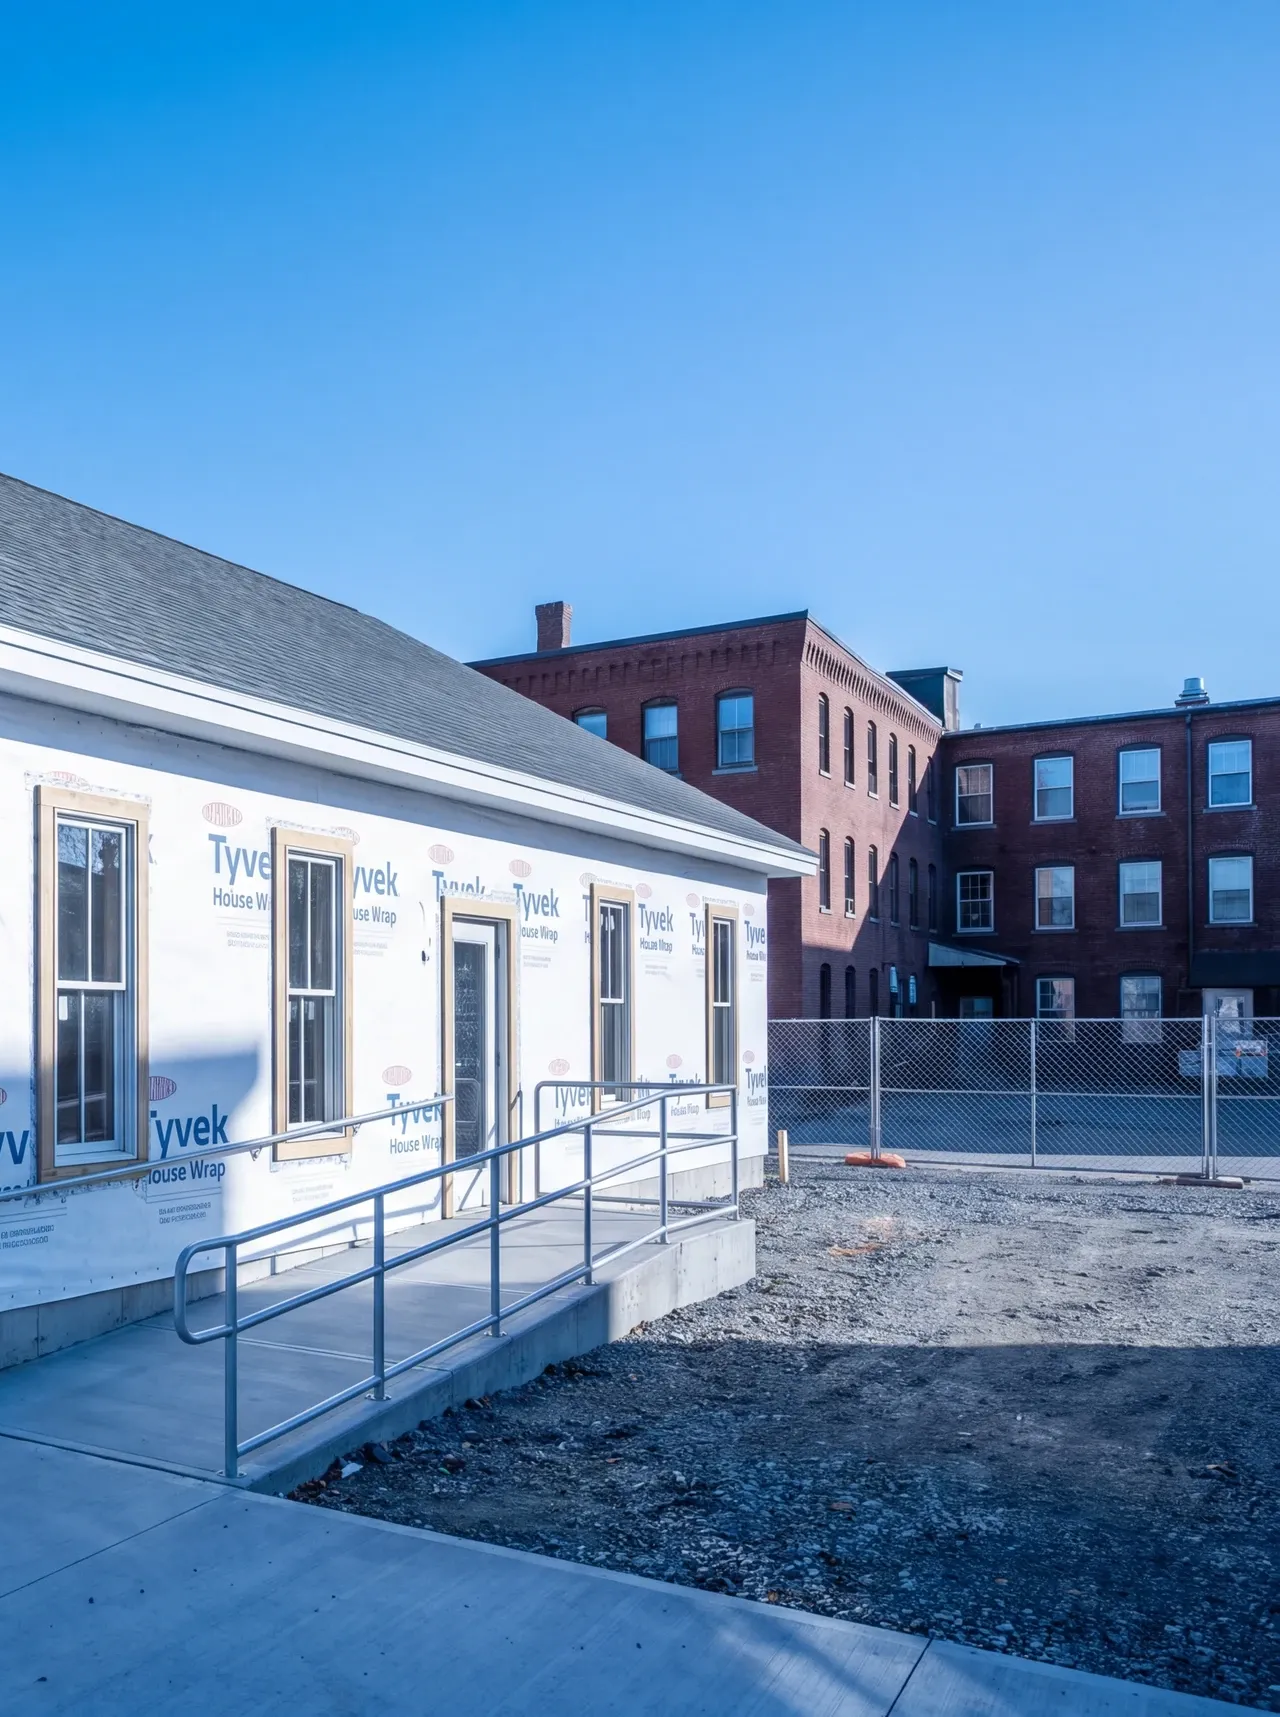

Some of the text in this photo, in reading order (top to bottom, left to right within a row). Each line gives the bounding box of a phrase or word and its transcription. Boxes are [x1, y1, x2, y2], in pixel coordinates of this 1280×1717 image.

[208, 833, 271, 885] Tyve
[213, 887, 253, 910] House
[353, 906, 397, 928] use Wrap
[638, 903, 674, 936] Tyvek
[744, 920, 766, 948] Tyve
[390, 1137, 420, 1154] House
[190, 1160, 226, 1182] Wrap
